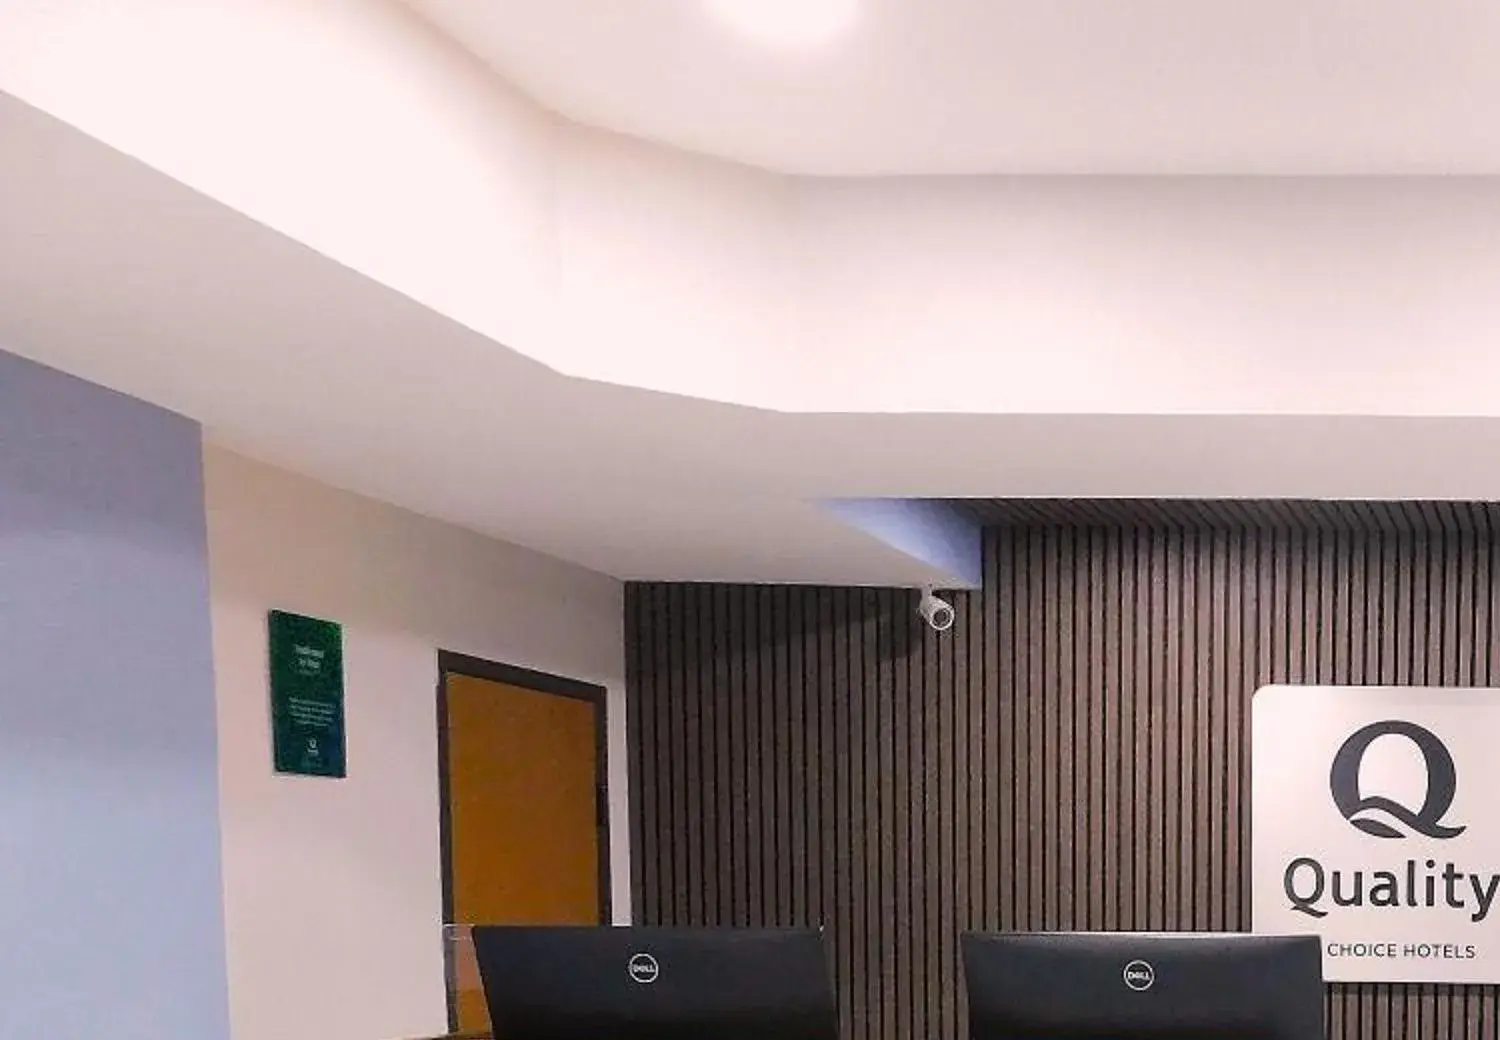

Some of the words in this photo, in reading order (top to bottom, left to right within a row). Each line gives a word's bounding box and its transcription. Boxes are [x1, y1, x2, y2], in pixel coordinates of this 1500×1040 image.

[1329, 719, 1467, 839] Q
[1327, 942, 1397, 958] CHOICE
[1402, 942, 1476, 959] HOTELS
